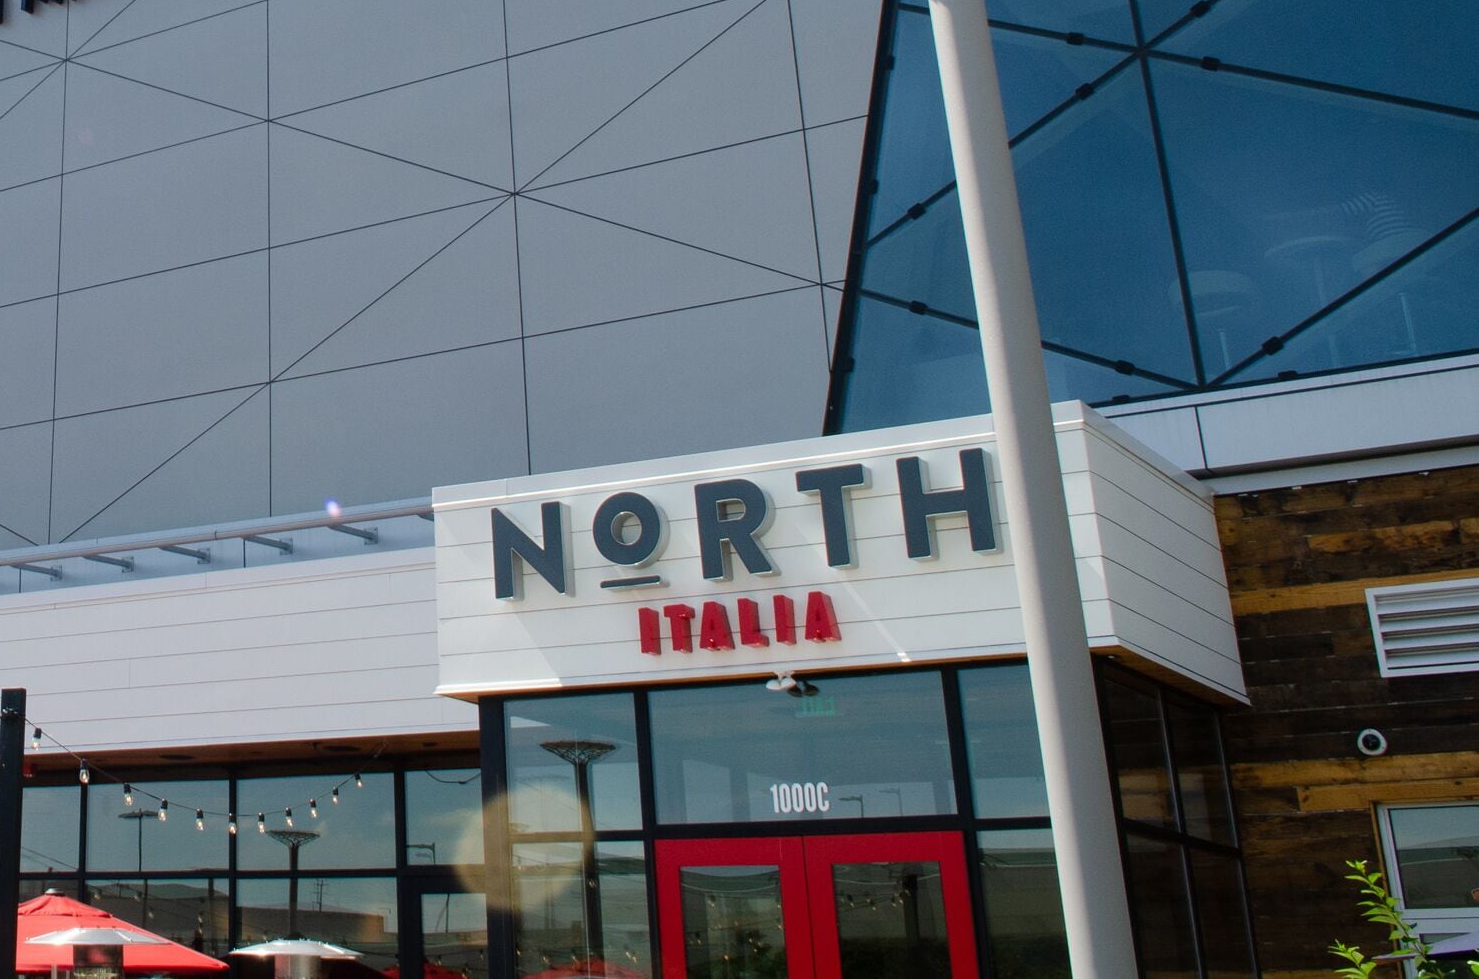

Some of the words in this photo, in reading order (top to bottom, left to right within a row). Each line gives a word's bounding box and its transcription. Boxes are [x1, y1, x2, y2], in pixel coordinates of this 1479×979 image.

[490, 447, 1003, 601] NORTH
[638, 590, 842, 656] ITALIA
[769, 781, 830, 813] 1000C
